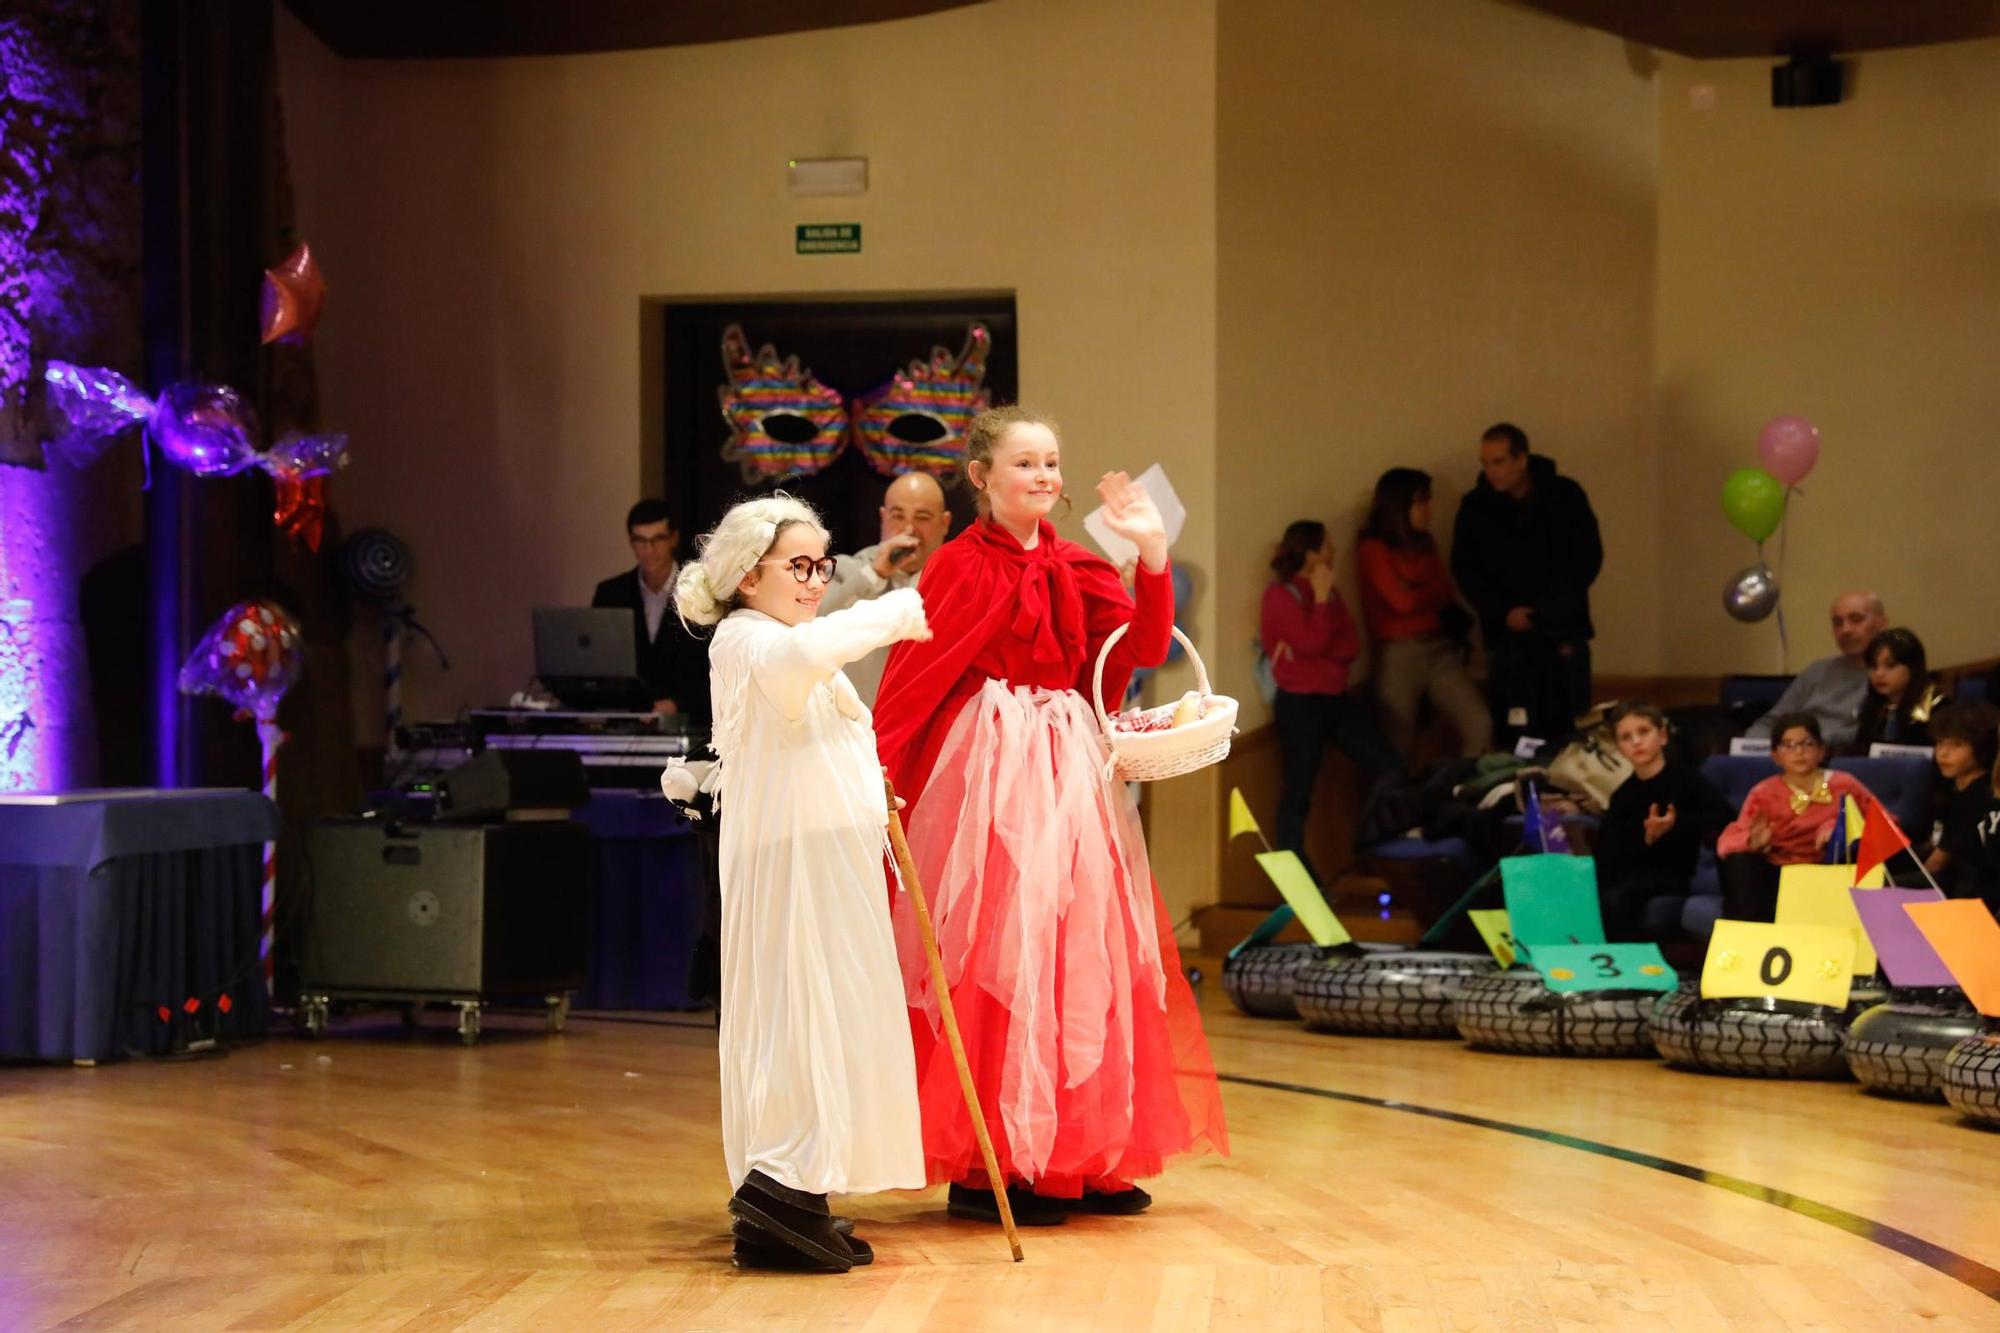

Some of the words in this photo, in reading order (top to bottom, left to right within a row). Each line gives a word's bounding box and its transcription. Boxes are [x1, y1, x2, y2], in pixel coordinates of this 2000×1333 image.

[805, 227, 837, 238] SALIDA
[840, 227, 852, 238] DE
[799, 240, 858, 251] EMERGENCIA
[1590, 953, 1621, 978] 3
